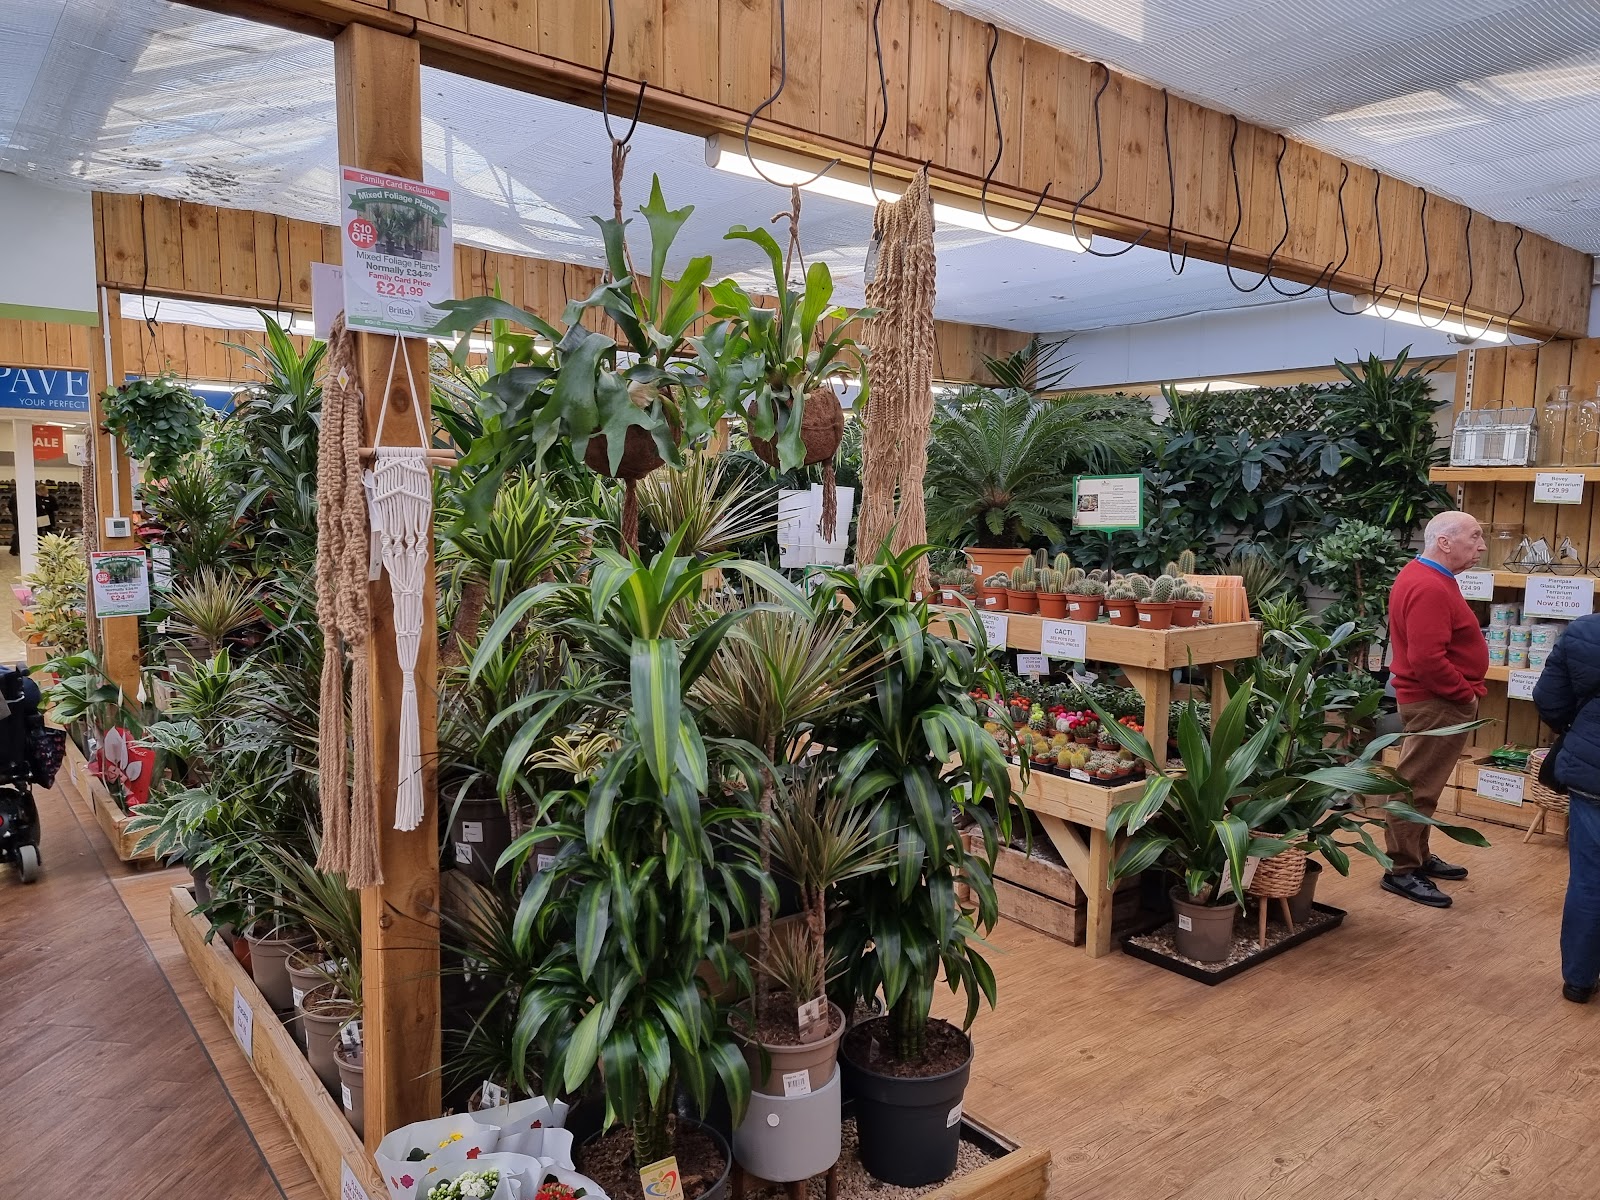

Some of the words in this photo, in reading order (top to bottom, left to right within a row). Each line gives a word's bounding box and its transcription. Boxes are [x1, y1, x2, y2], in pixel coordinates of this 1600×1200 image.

[360, 174, 385, 188] Family
[386, 179, 403, 190] Card
[404, 183, 436, 196] Exclusive
[358, 190, 382, 200] Mixed
[384, 191, 413, 204] Foliage
[414, 198, 439, 216] Plants
[352, 223, 372, 234] £10
[351, 232, 374, 244] OFF
[356, 250, 382, 262] Mixed
[383, 255, 412, 270] Foliage
[366, 262, 405, 276] Normally
[368, 272, 394, 284] Family
[394, 274, 412, 285] Card
[412, 277, 432, 288] Price
[376, 281, 424, 297] £24.99
[388, 304, 413, 315] British
[19, 398, 46, 407] YOUR
[49, 400, 86, 409] PERFECT
[34, 437, 59, 448] ALE
[1054, 628, 1073, 636] CACTI
[1492, 785, 1509, 793] £3.99
